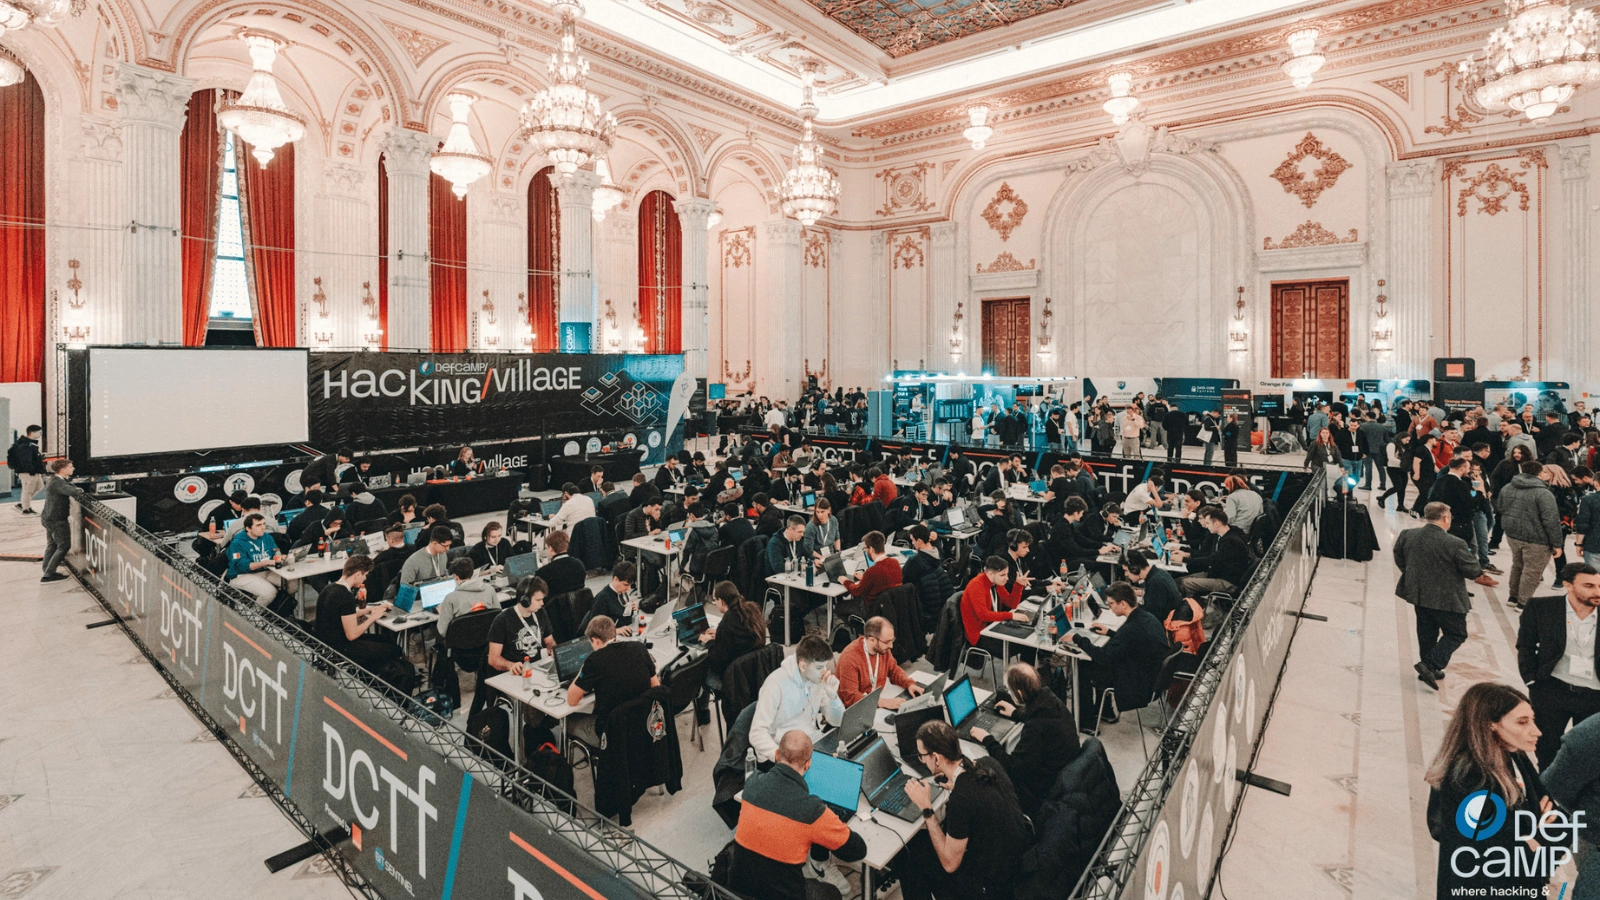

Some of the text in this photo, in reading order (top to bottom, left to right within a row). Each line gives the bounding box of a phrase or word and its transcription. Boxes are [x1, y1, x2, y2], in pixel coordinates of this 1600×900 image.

[1098, 464, 1135, 495] Tf
[160, 590, 203, 666] DCTf
[223, 640, 288, 745] DCTf
[322, 721, 438, 880] DCTf
